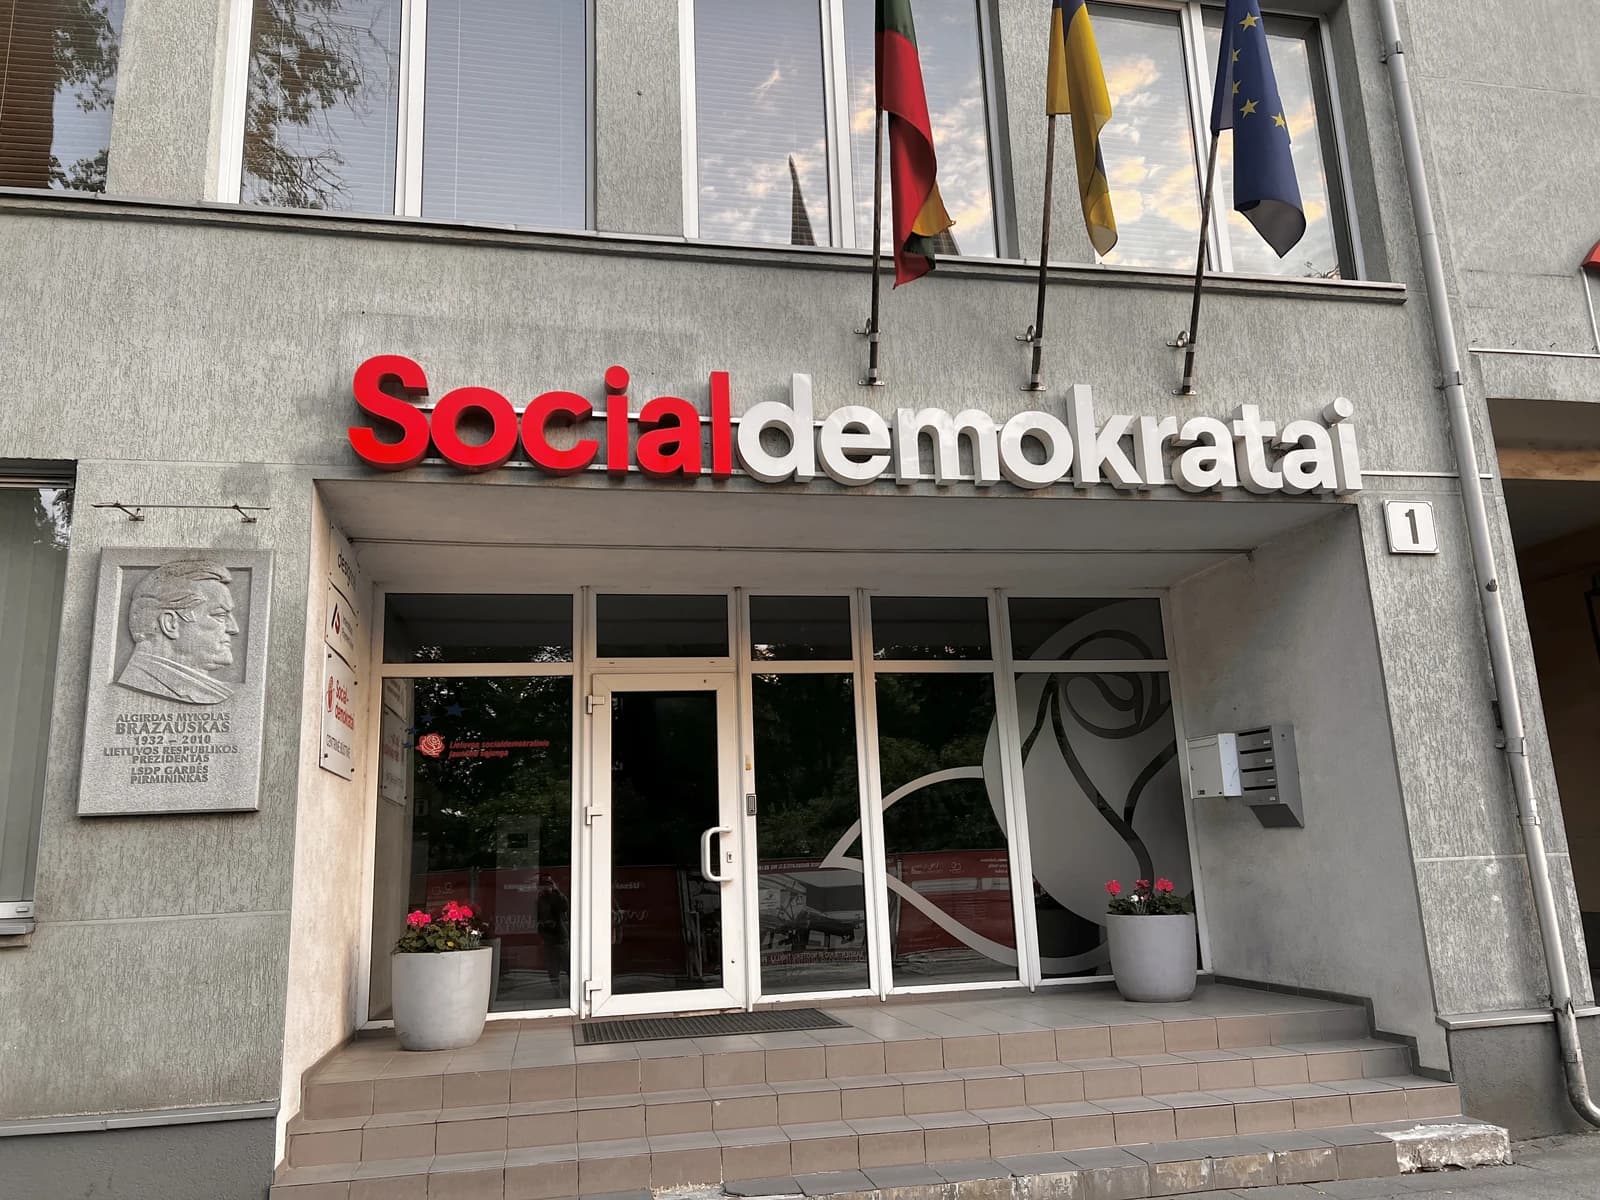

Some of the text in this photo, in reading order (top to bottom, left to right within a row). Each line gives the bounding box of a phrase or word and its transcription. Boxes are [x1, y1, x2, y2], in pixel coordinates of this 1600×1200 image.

[348, 355, 1362, 493] Socialdemokratai
[1405, 508, 1420, 545] 1
[115, 712, 231, 723] ALGIRDAS MYKOLAS
[115, 721, 230, 735] BRAZAUSKAS
[134, 735, 164, 745] 1932
[182, 734, 211, 744] 2010
[103, 744, 238, 756] LIETUVOS RESPUBLIKOS
[132, 754, 210, 764] PREZIDENTAS
[131, 762, 209, 776] LSDP GARBĖS
[130, 774, 209, 784] PIRMININKAS
